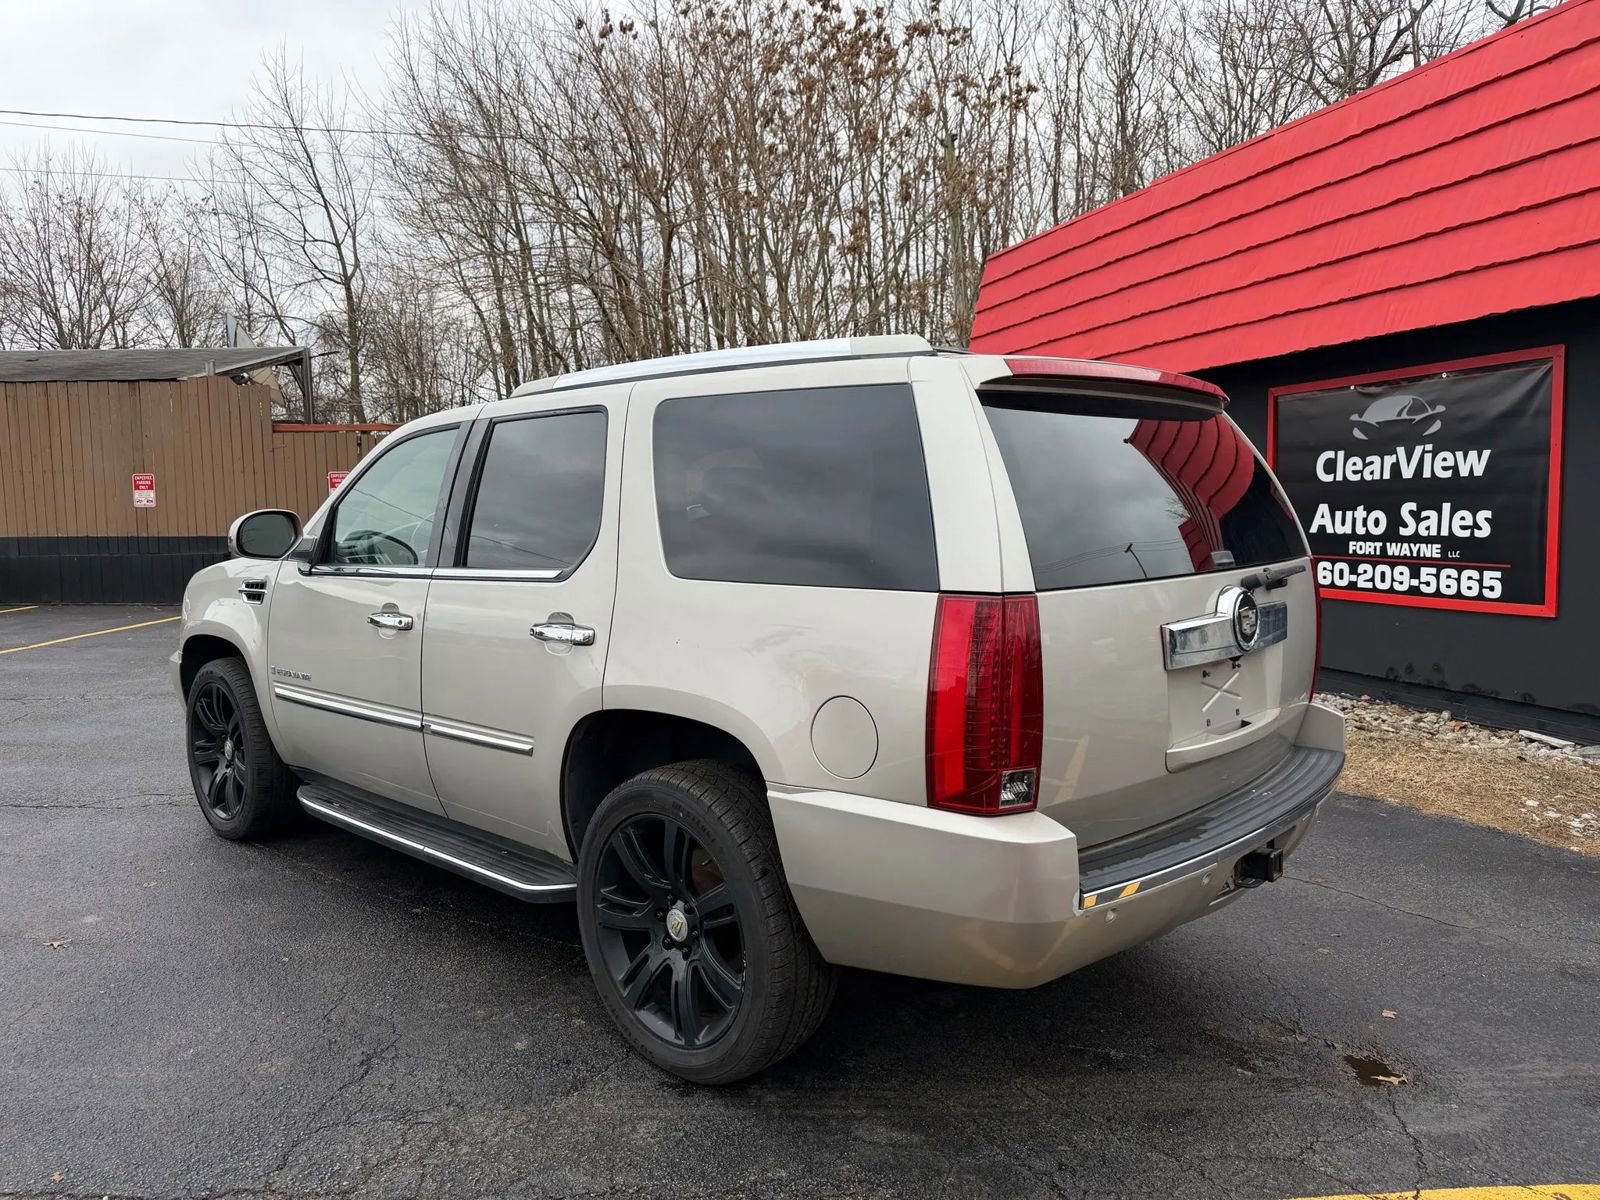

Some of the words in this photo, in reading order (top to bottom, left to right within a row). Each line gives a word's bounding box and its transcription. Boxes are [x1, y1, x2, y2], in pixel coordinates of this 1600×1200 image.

[1316, 444, 1492, 482] ClearView
[1309, 503, 1387, 535] Auto
[1399, 502, 1492, 538] Sales
[1349, 541, 1383, 556] FORT
[1386, 542, 1441, 558] WAYNE
[1448, 550, 1461, 558] LLC
[1317, 561, 1503, 599] 60-209-5665
